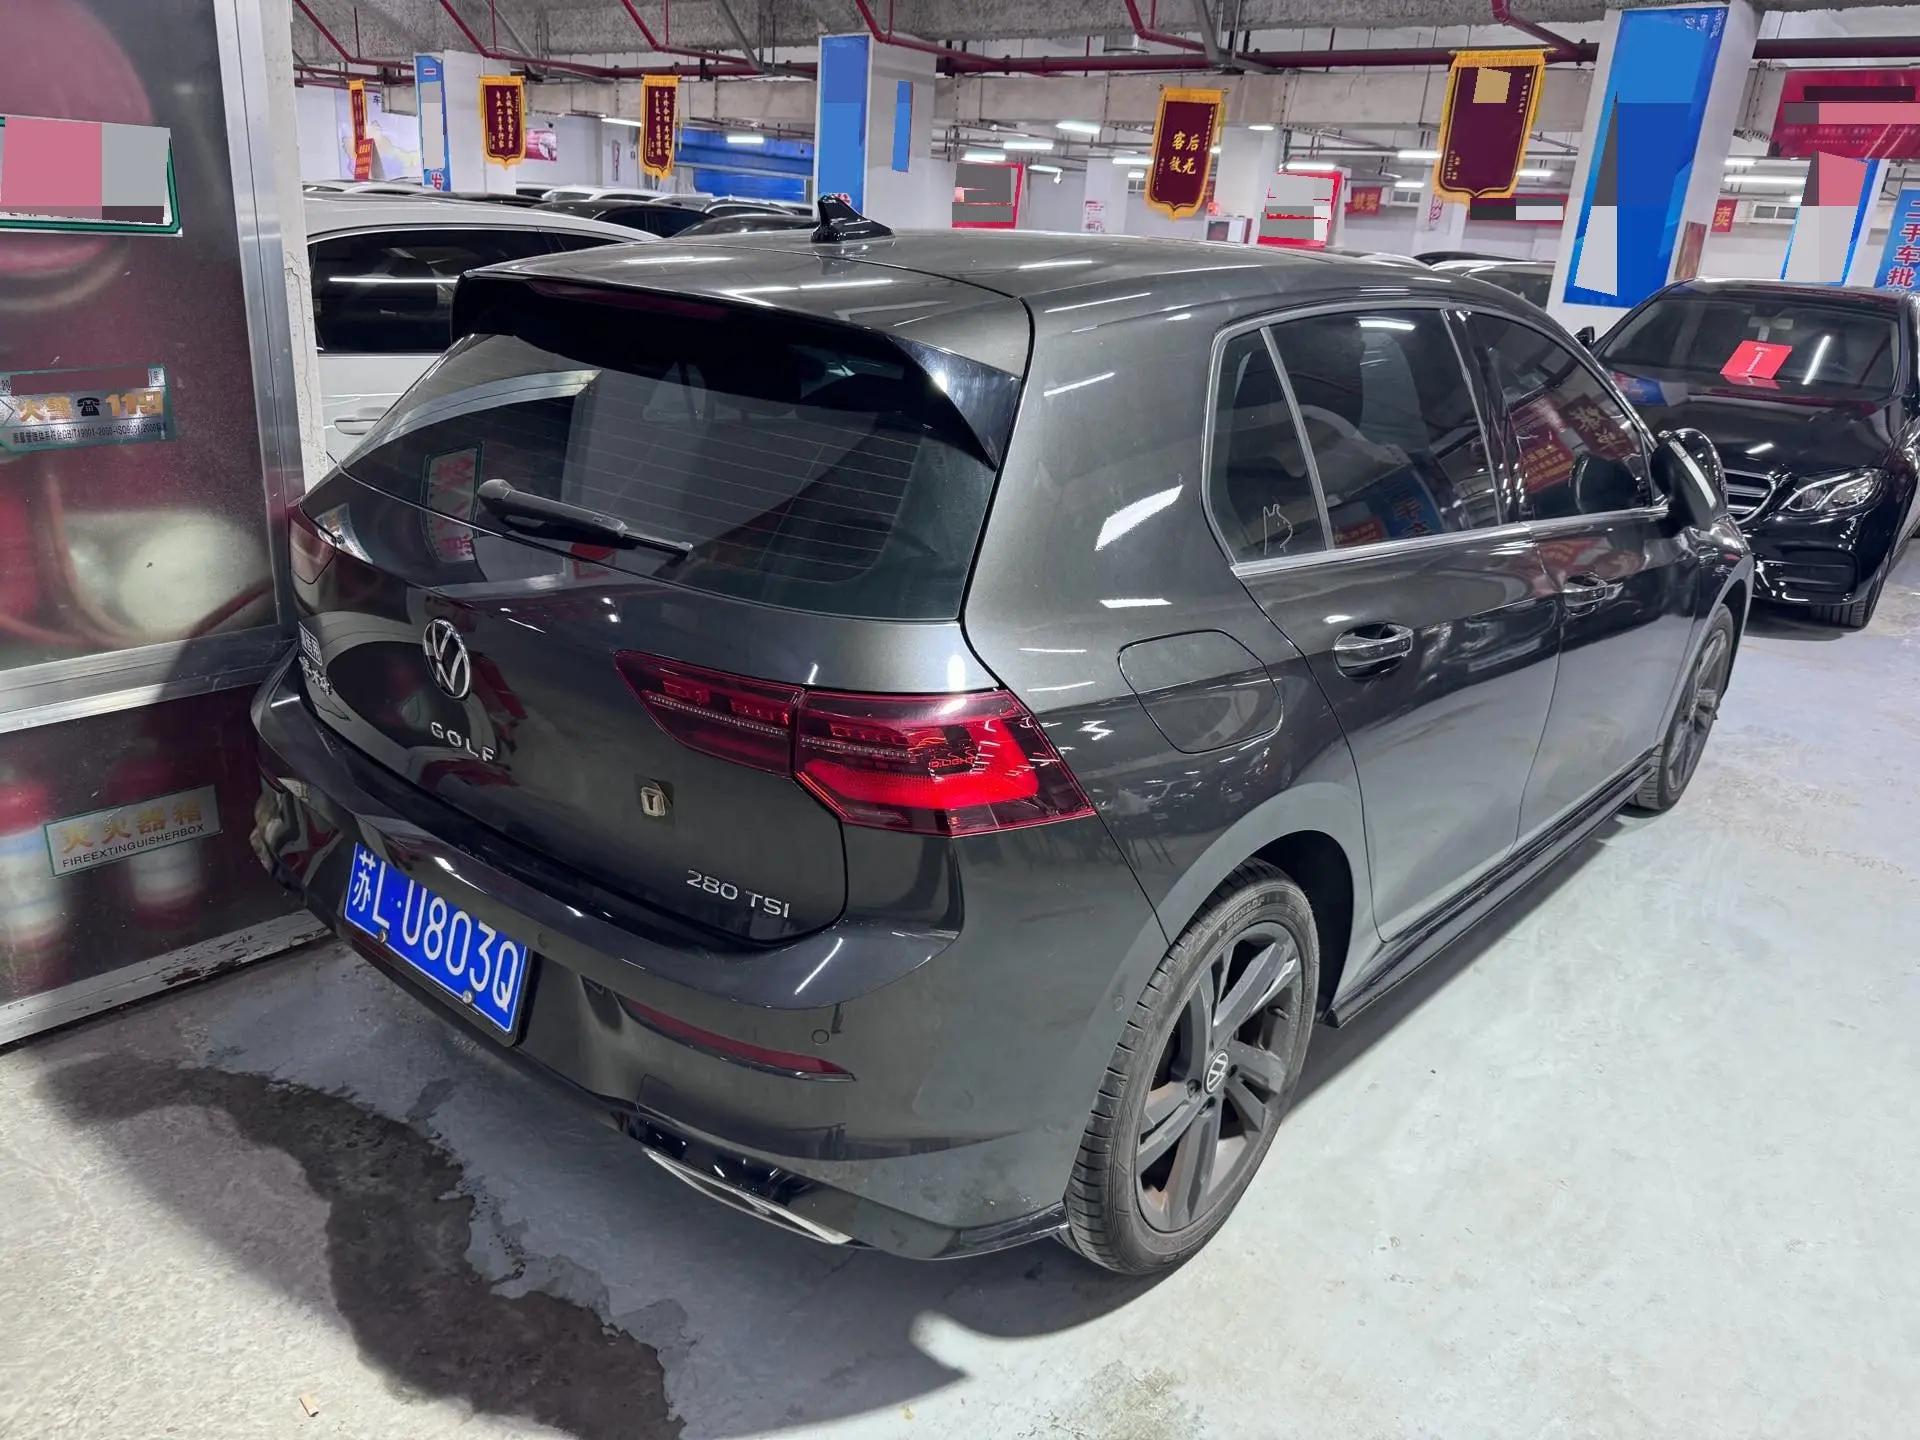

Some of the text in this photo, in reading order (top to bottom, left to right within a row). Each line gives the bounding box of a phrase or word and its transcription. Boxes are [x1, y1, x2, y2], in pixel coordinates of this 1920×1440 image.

[1887, 200, 1920, 292] 二手车批
[431, 721, 495, 762] GOLF
[62, 823, 206, 868] FIREEXTINGUISHERBOX
[63, 800, 202, 854] 灭火器箱
[686, 869, 790, 918] 280 TSI
